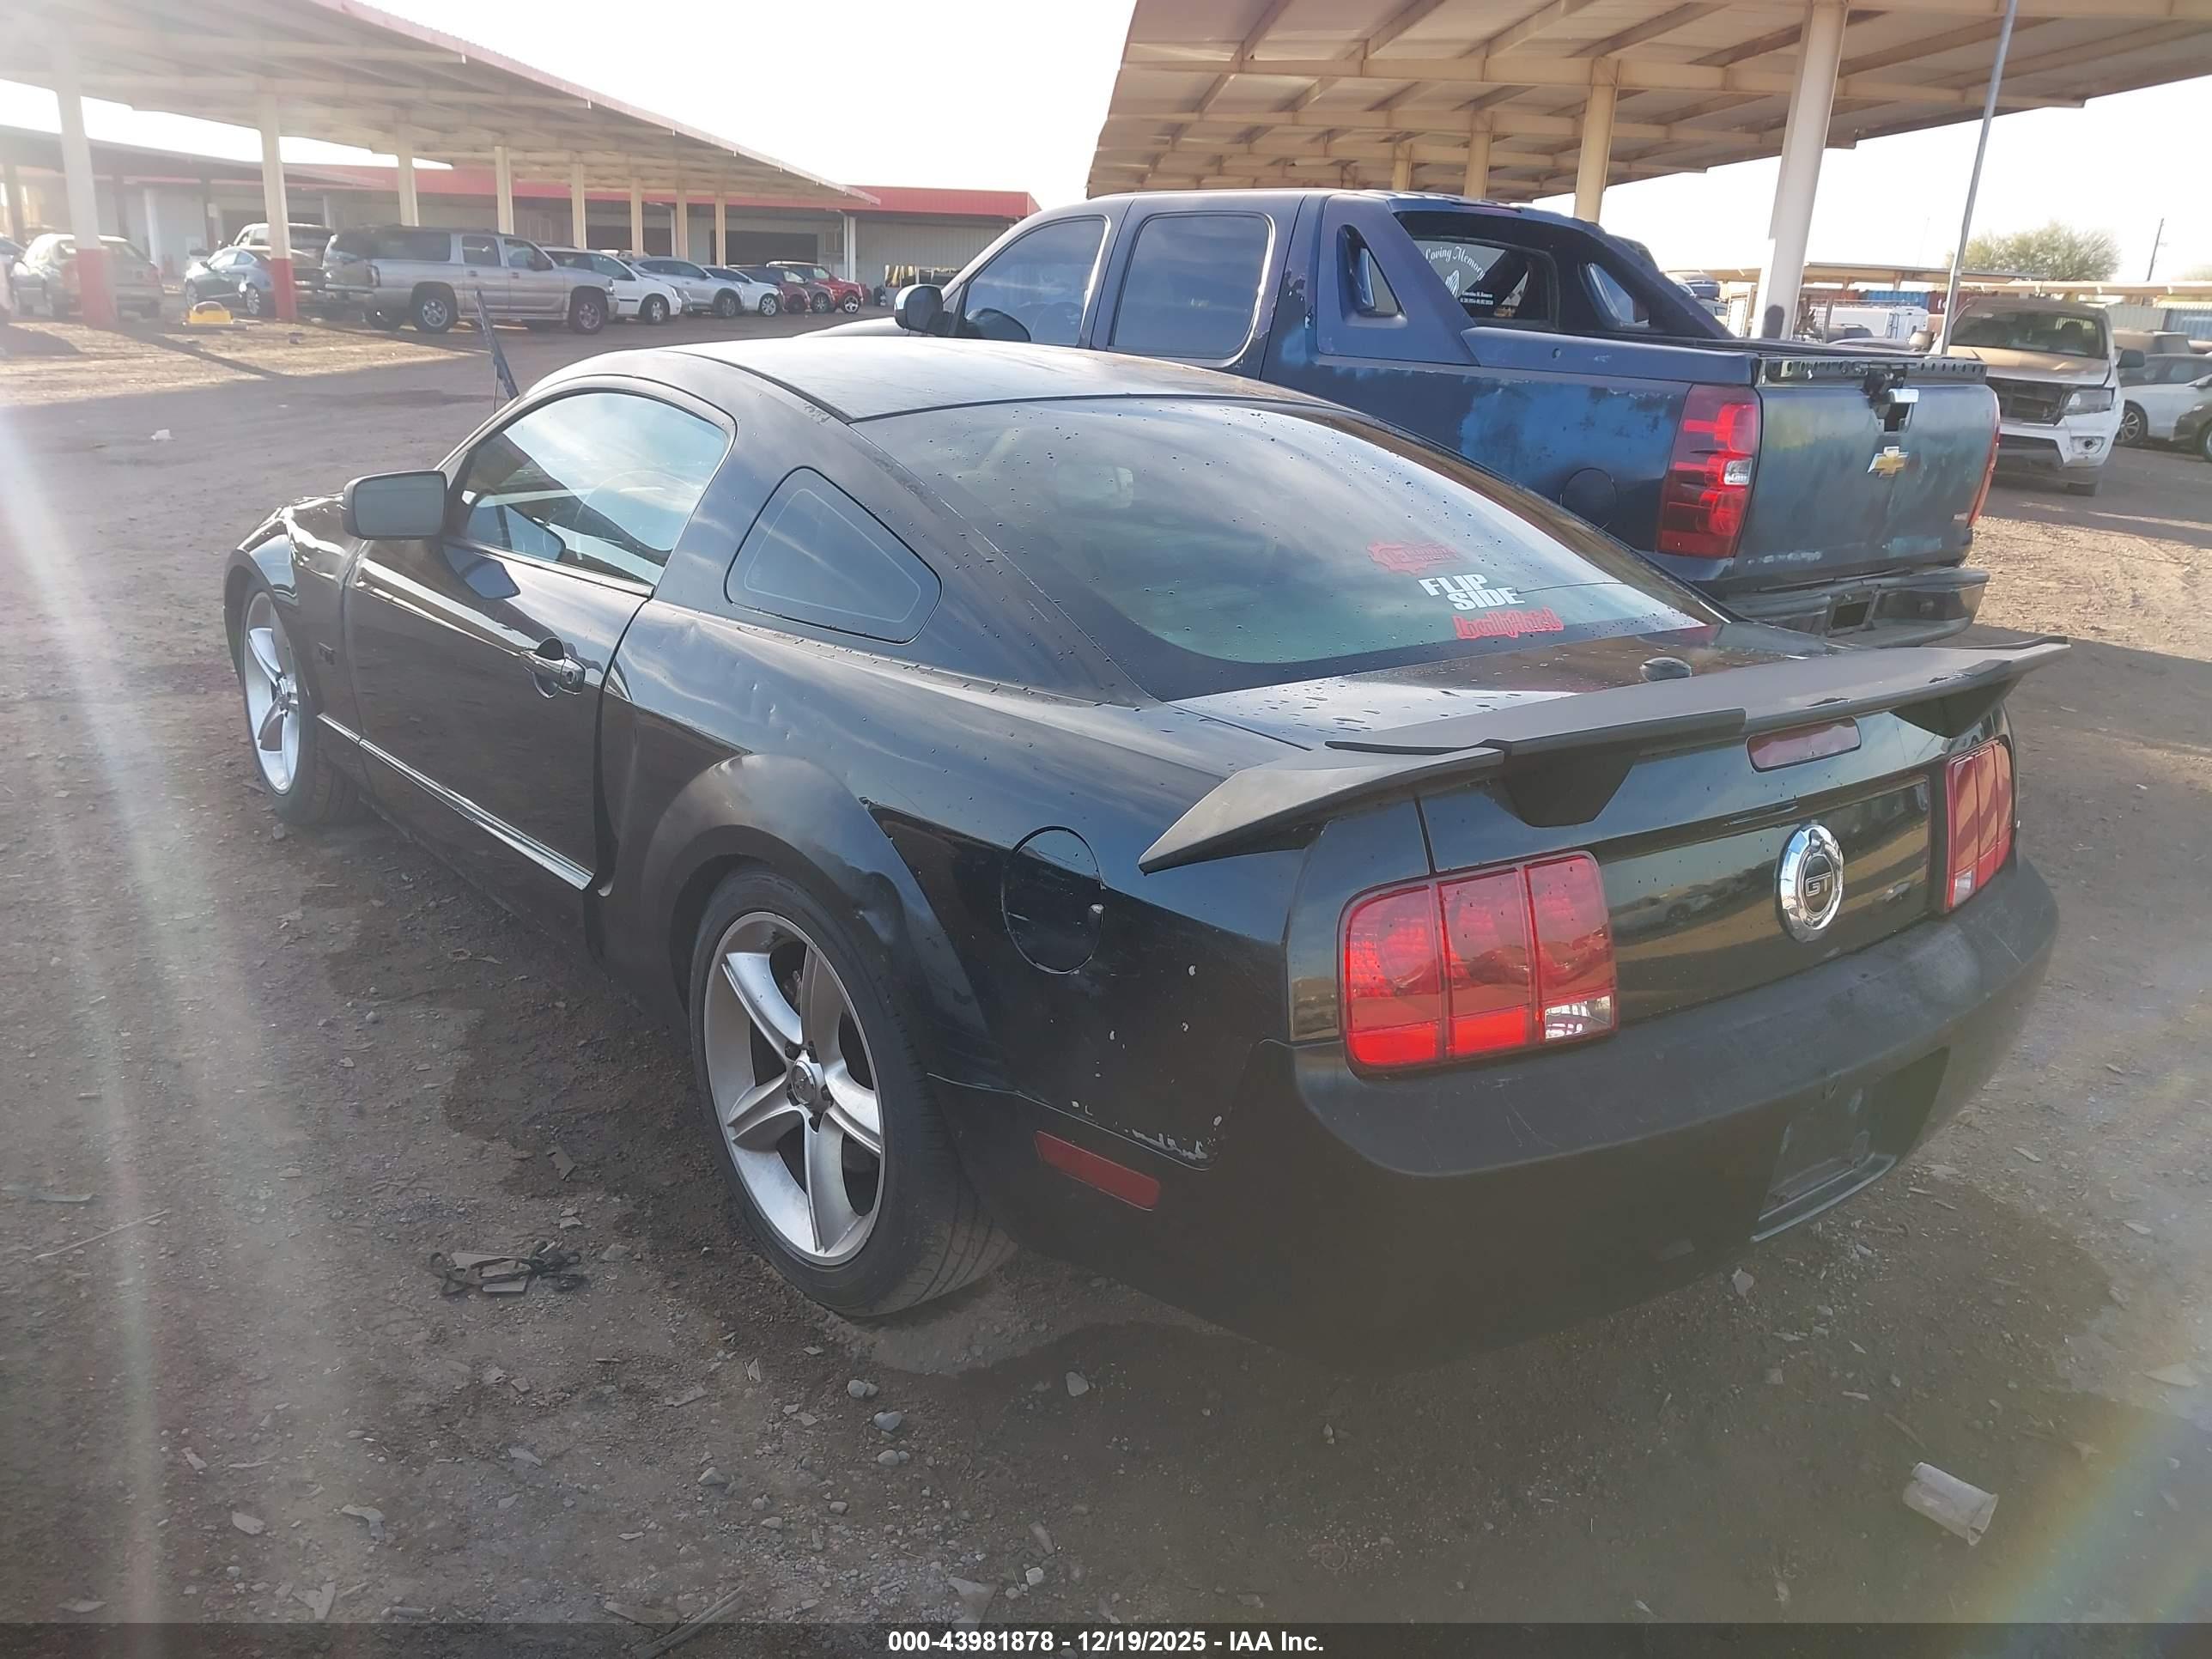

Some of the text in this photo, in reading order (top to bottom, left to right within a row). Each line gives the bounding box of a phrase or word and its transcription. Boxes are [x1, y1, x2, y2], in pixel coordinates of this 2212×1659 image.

[1425, 246, 1486, 282] Loving Memory
[1418, 574, 1487, 597] FLIP
[1445, 586, 1526, 611] SIDE
[1805, 872, 1832, 897] GT
